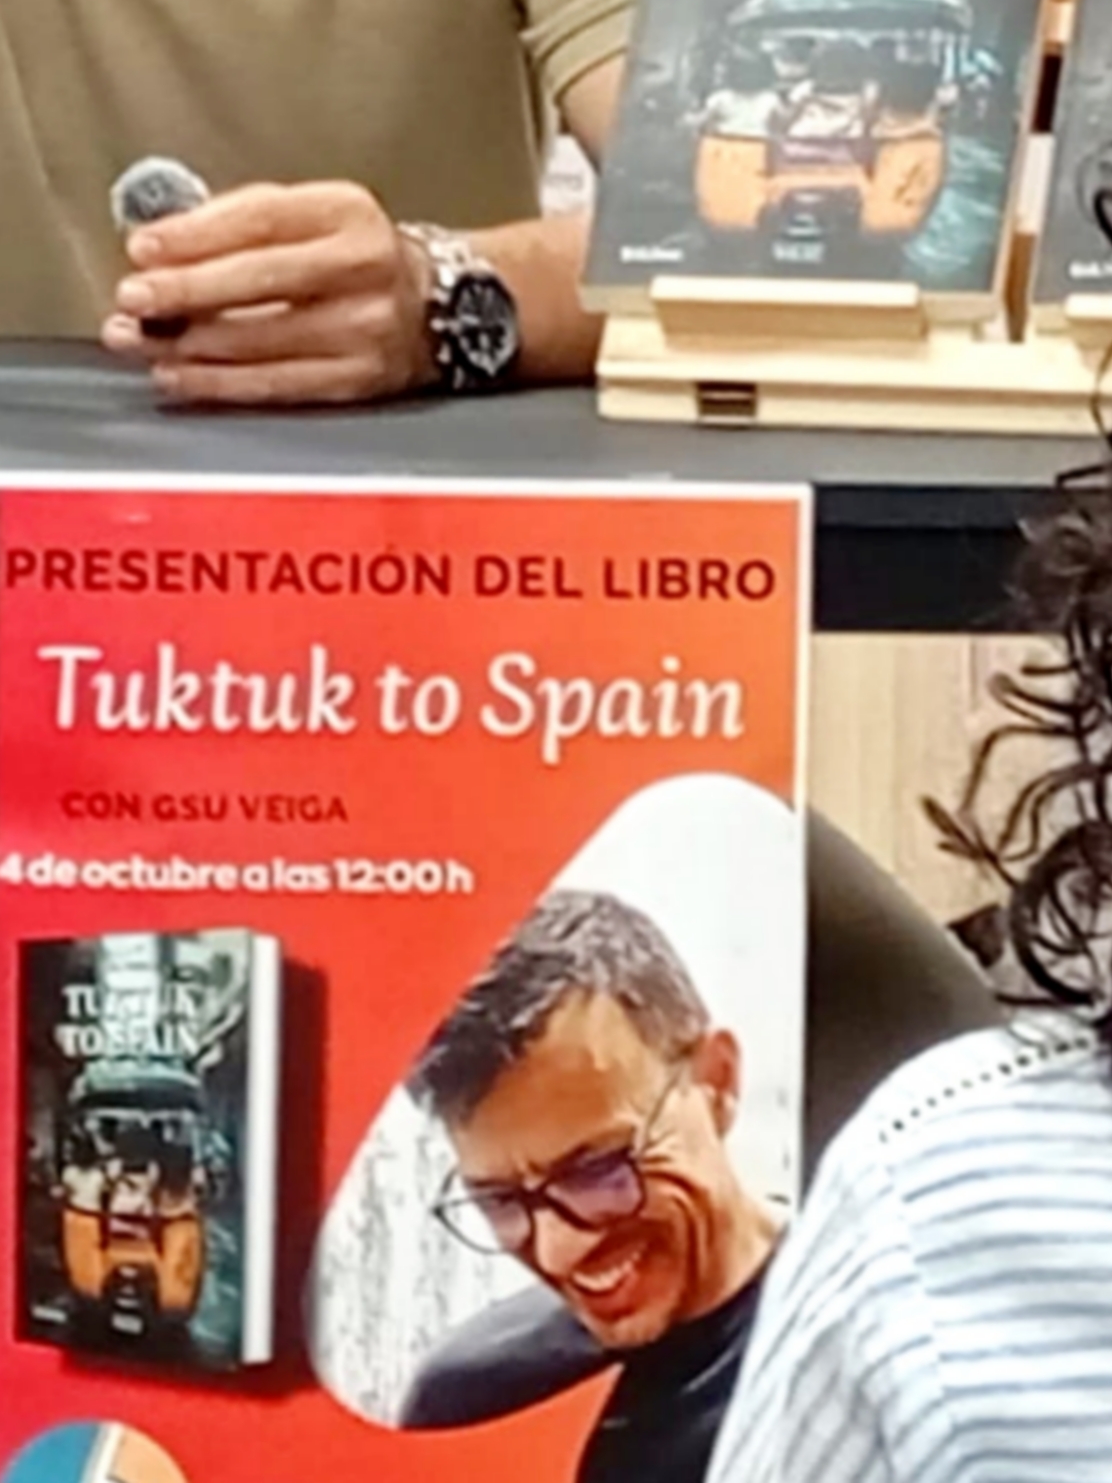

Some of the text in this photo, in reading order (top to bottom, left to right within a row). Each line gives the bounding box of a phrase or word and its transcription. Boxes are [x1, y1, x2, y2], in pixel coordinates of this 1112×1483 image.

[4, 543, 777, 604] PRESENTACIÓN DEL LIBRO
[37, 642, 745, 765] Tuktuk to Spain
[59, 791, 349, 825] CON GSU VEIGA
[25, 851, 79, 887] de
[80, 855, 238, 891] octubre
[241, 861, 271, 891] a
[272, 857, 331, 892] las
[334, 858, 444, 894] 12:00
[445, 859, 474, 894] h
